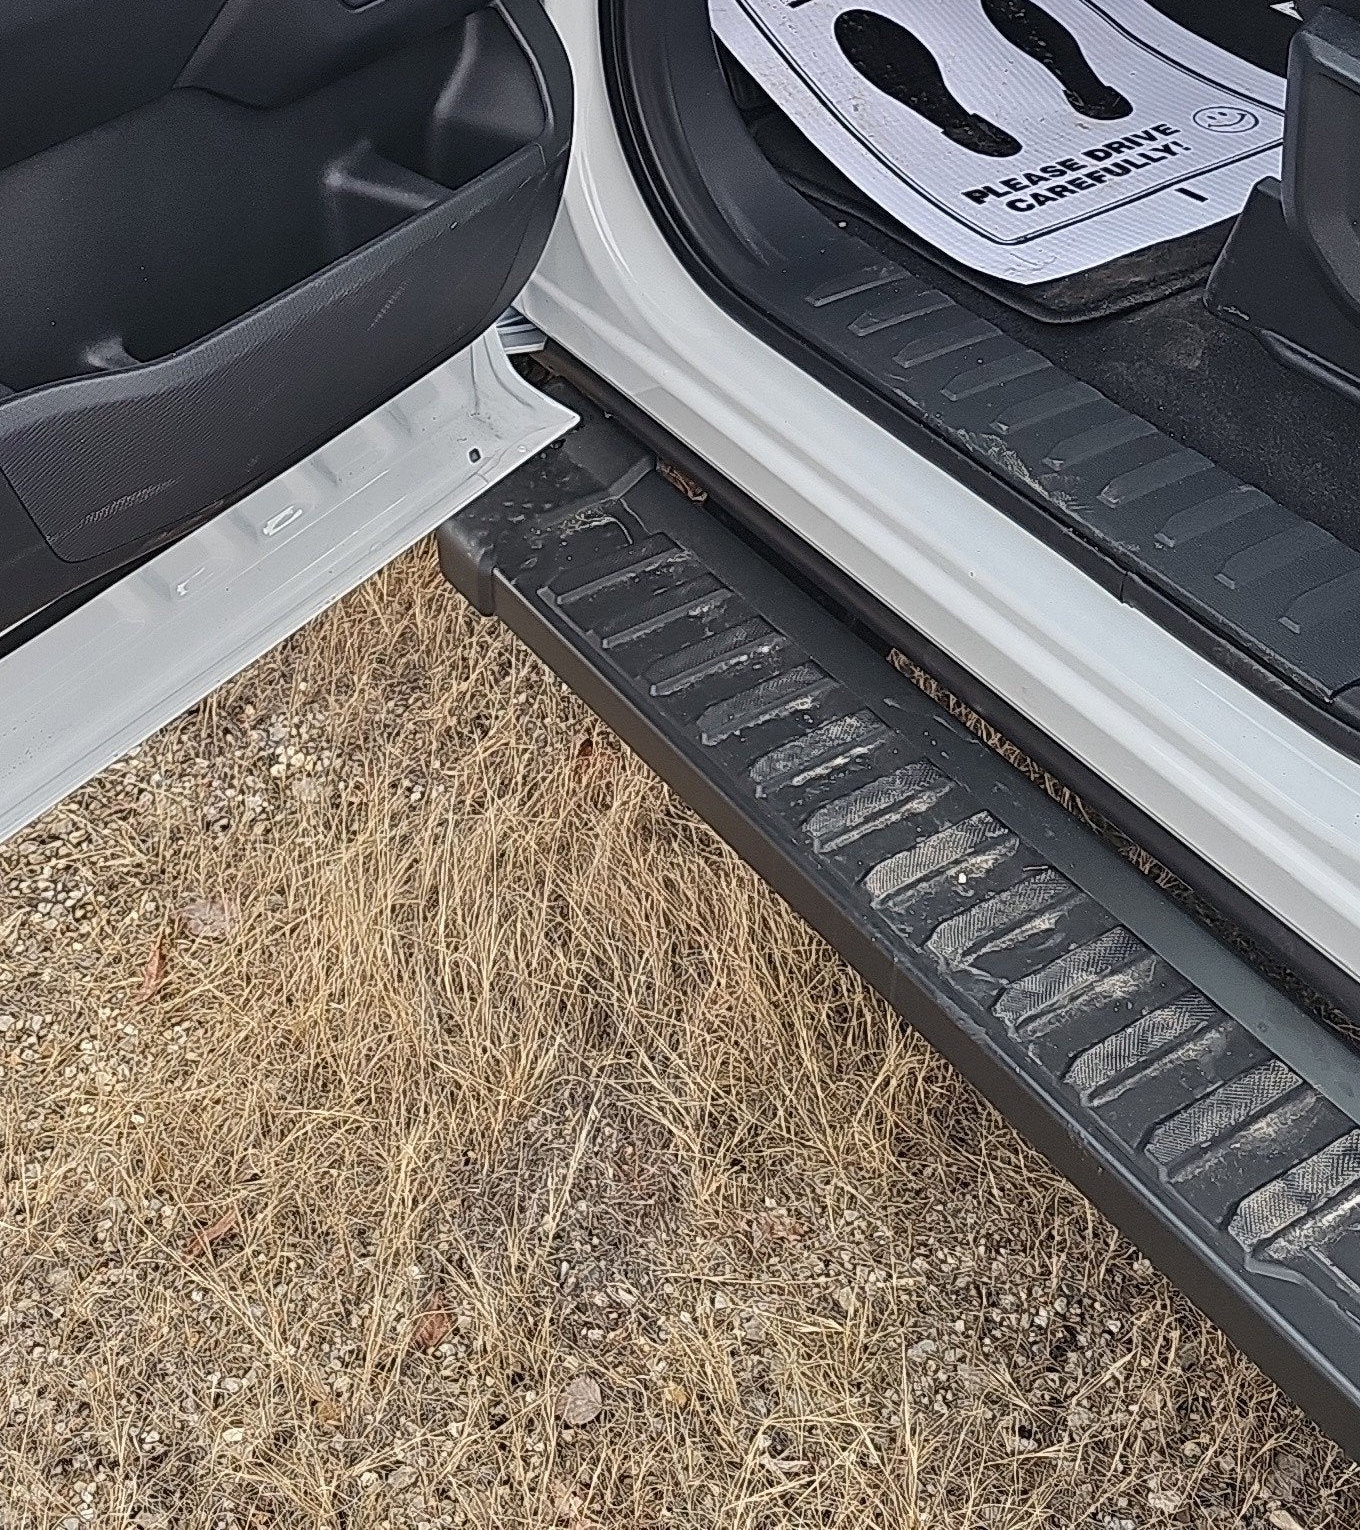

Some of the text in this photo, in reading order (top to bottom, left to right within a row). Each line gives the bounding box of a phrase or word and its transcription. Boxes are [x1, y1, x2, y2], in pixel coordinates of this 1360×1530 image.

[961, 123, 1181, 205] PLEASE DRIVE
[1005, 140, 1192, 212] CAREFULLY!
